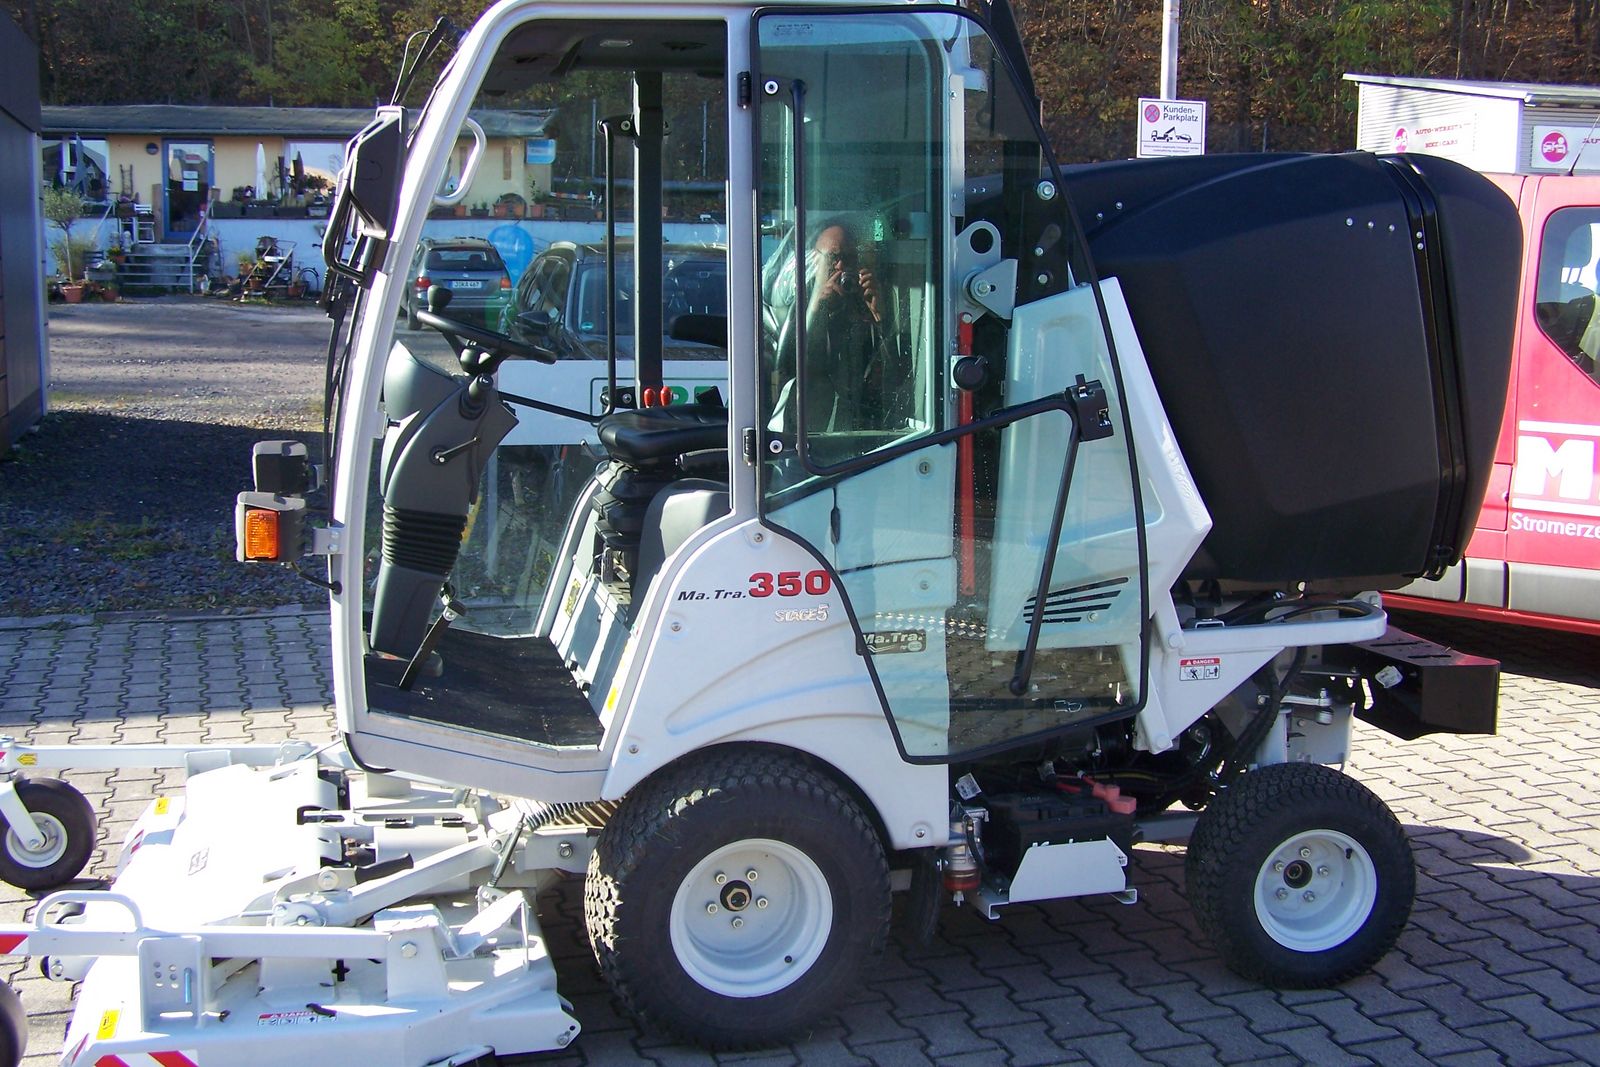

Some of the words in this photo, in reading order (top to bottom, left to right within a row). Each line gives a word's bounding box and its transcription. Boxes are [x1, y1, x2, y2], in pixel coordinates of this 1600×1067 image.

[1163, 105, 1195, 114] Kunden-
[1163, 113, 1199, 123] Parkplatz
[1513, 435, 1600, 500] M
[749, 570, 831, 597] 350
